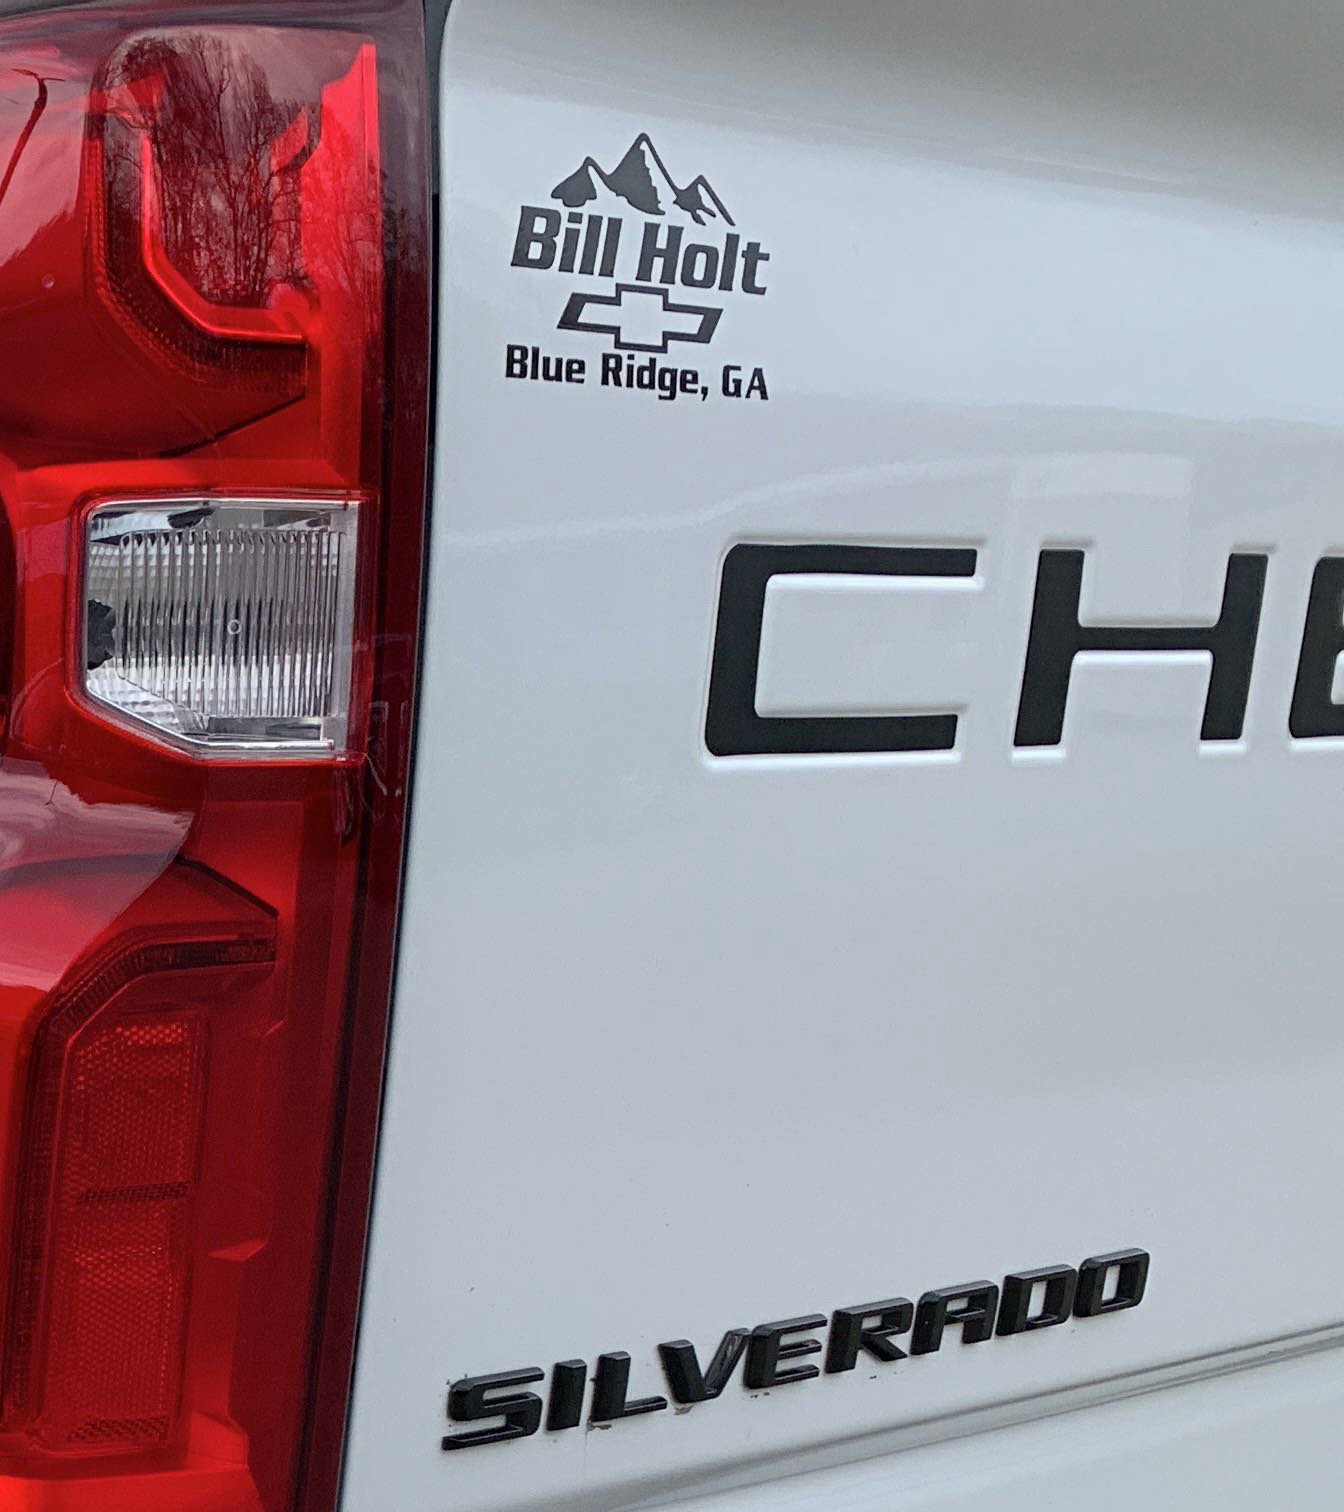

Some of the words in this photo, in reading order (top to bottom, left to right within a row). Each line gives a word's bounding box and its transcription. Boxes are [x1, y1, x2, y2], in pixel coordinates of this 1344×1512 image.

[510, 205, 623, 278] Bill
[635, 221, 771, 296] Holt
[505, 343, 586, 384] Blue
[600, 352, 710, 402] Ridge,
[721, 364, 770, 401] GA
[704, 543, 1344, 757] CH
[441, 1247, 1151, 1451] SILVERADO
